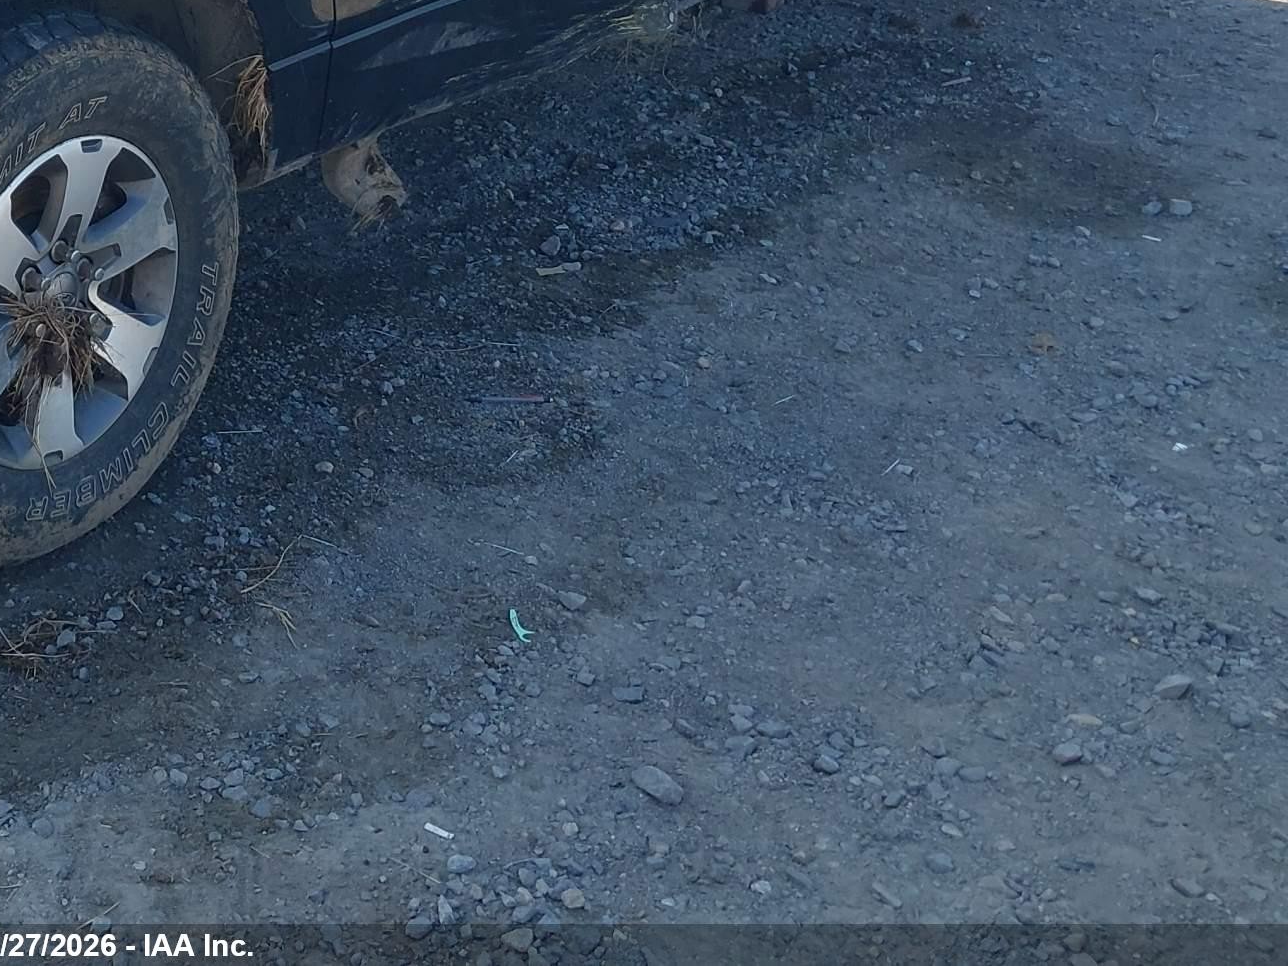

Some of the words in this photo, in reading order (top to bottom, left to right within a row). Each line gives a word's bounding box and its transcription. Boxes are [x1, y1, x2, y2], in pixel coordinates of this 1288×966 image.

[57, 95, 108, 132] AT
[170, 261, 221, 391] TRAIL
[25, 400, 173, 523] CLIMBER
